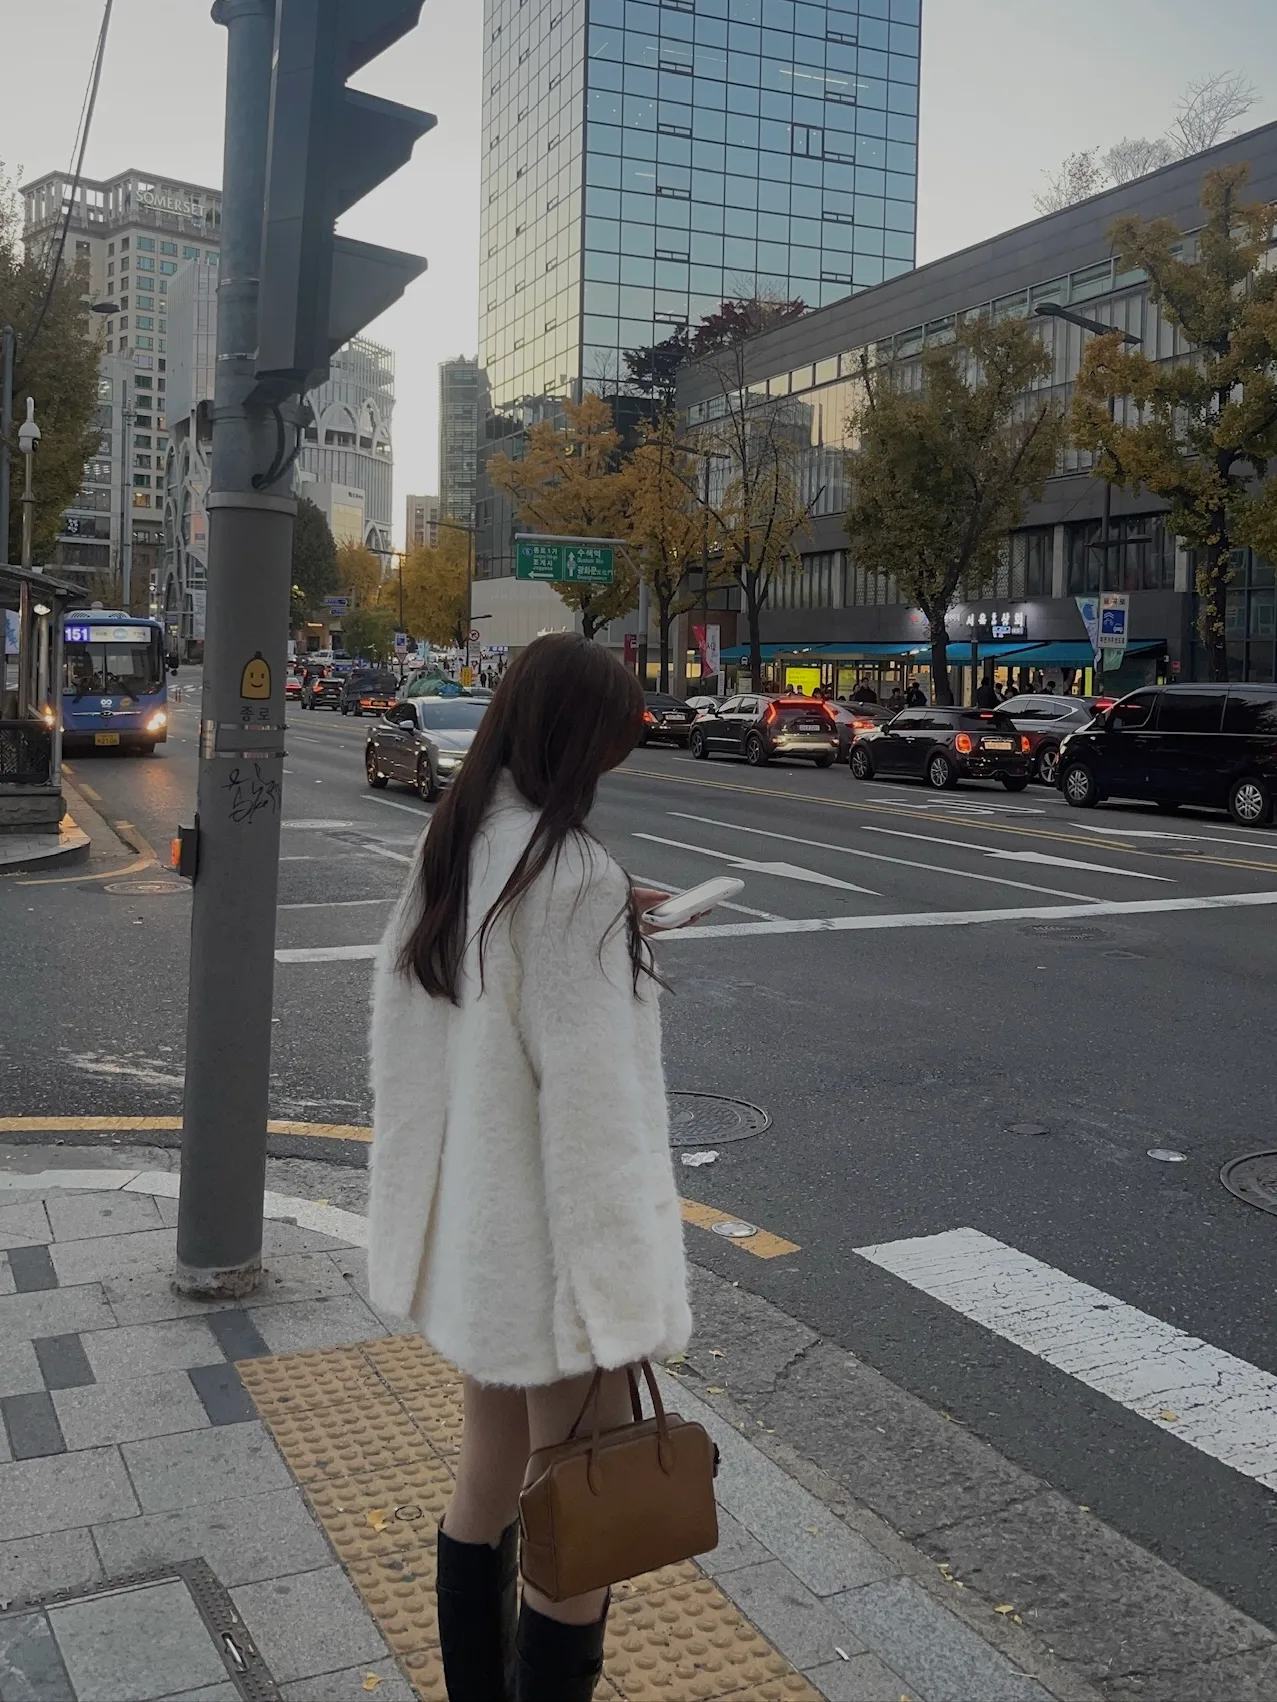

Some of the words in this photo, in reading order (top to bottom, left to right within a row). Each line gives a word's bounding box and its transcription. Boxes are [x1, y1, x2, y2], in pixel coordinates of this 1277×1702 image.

[136, 190, 205, 216] SOMERSET
[577, 548, 601, 558] 수색역
[65, 627, 88, 641] 151
[240, 706, 270, 722] 종로
